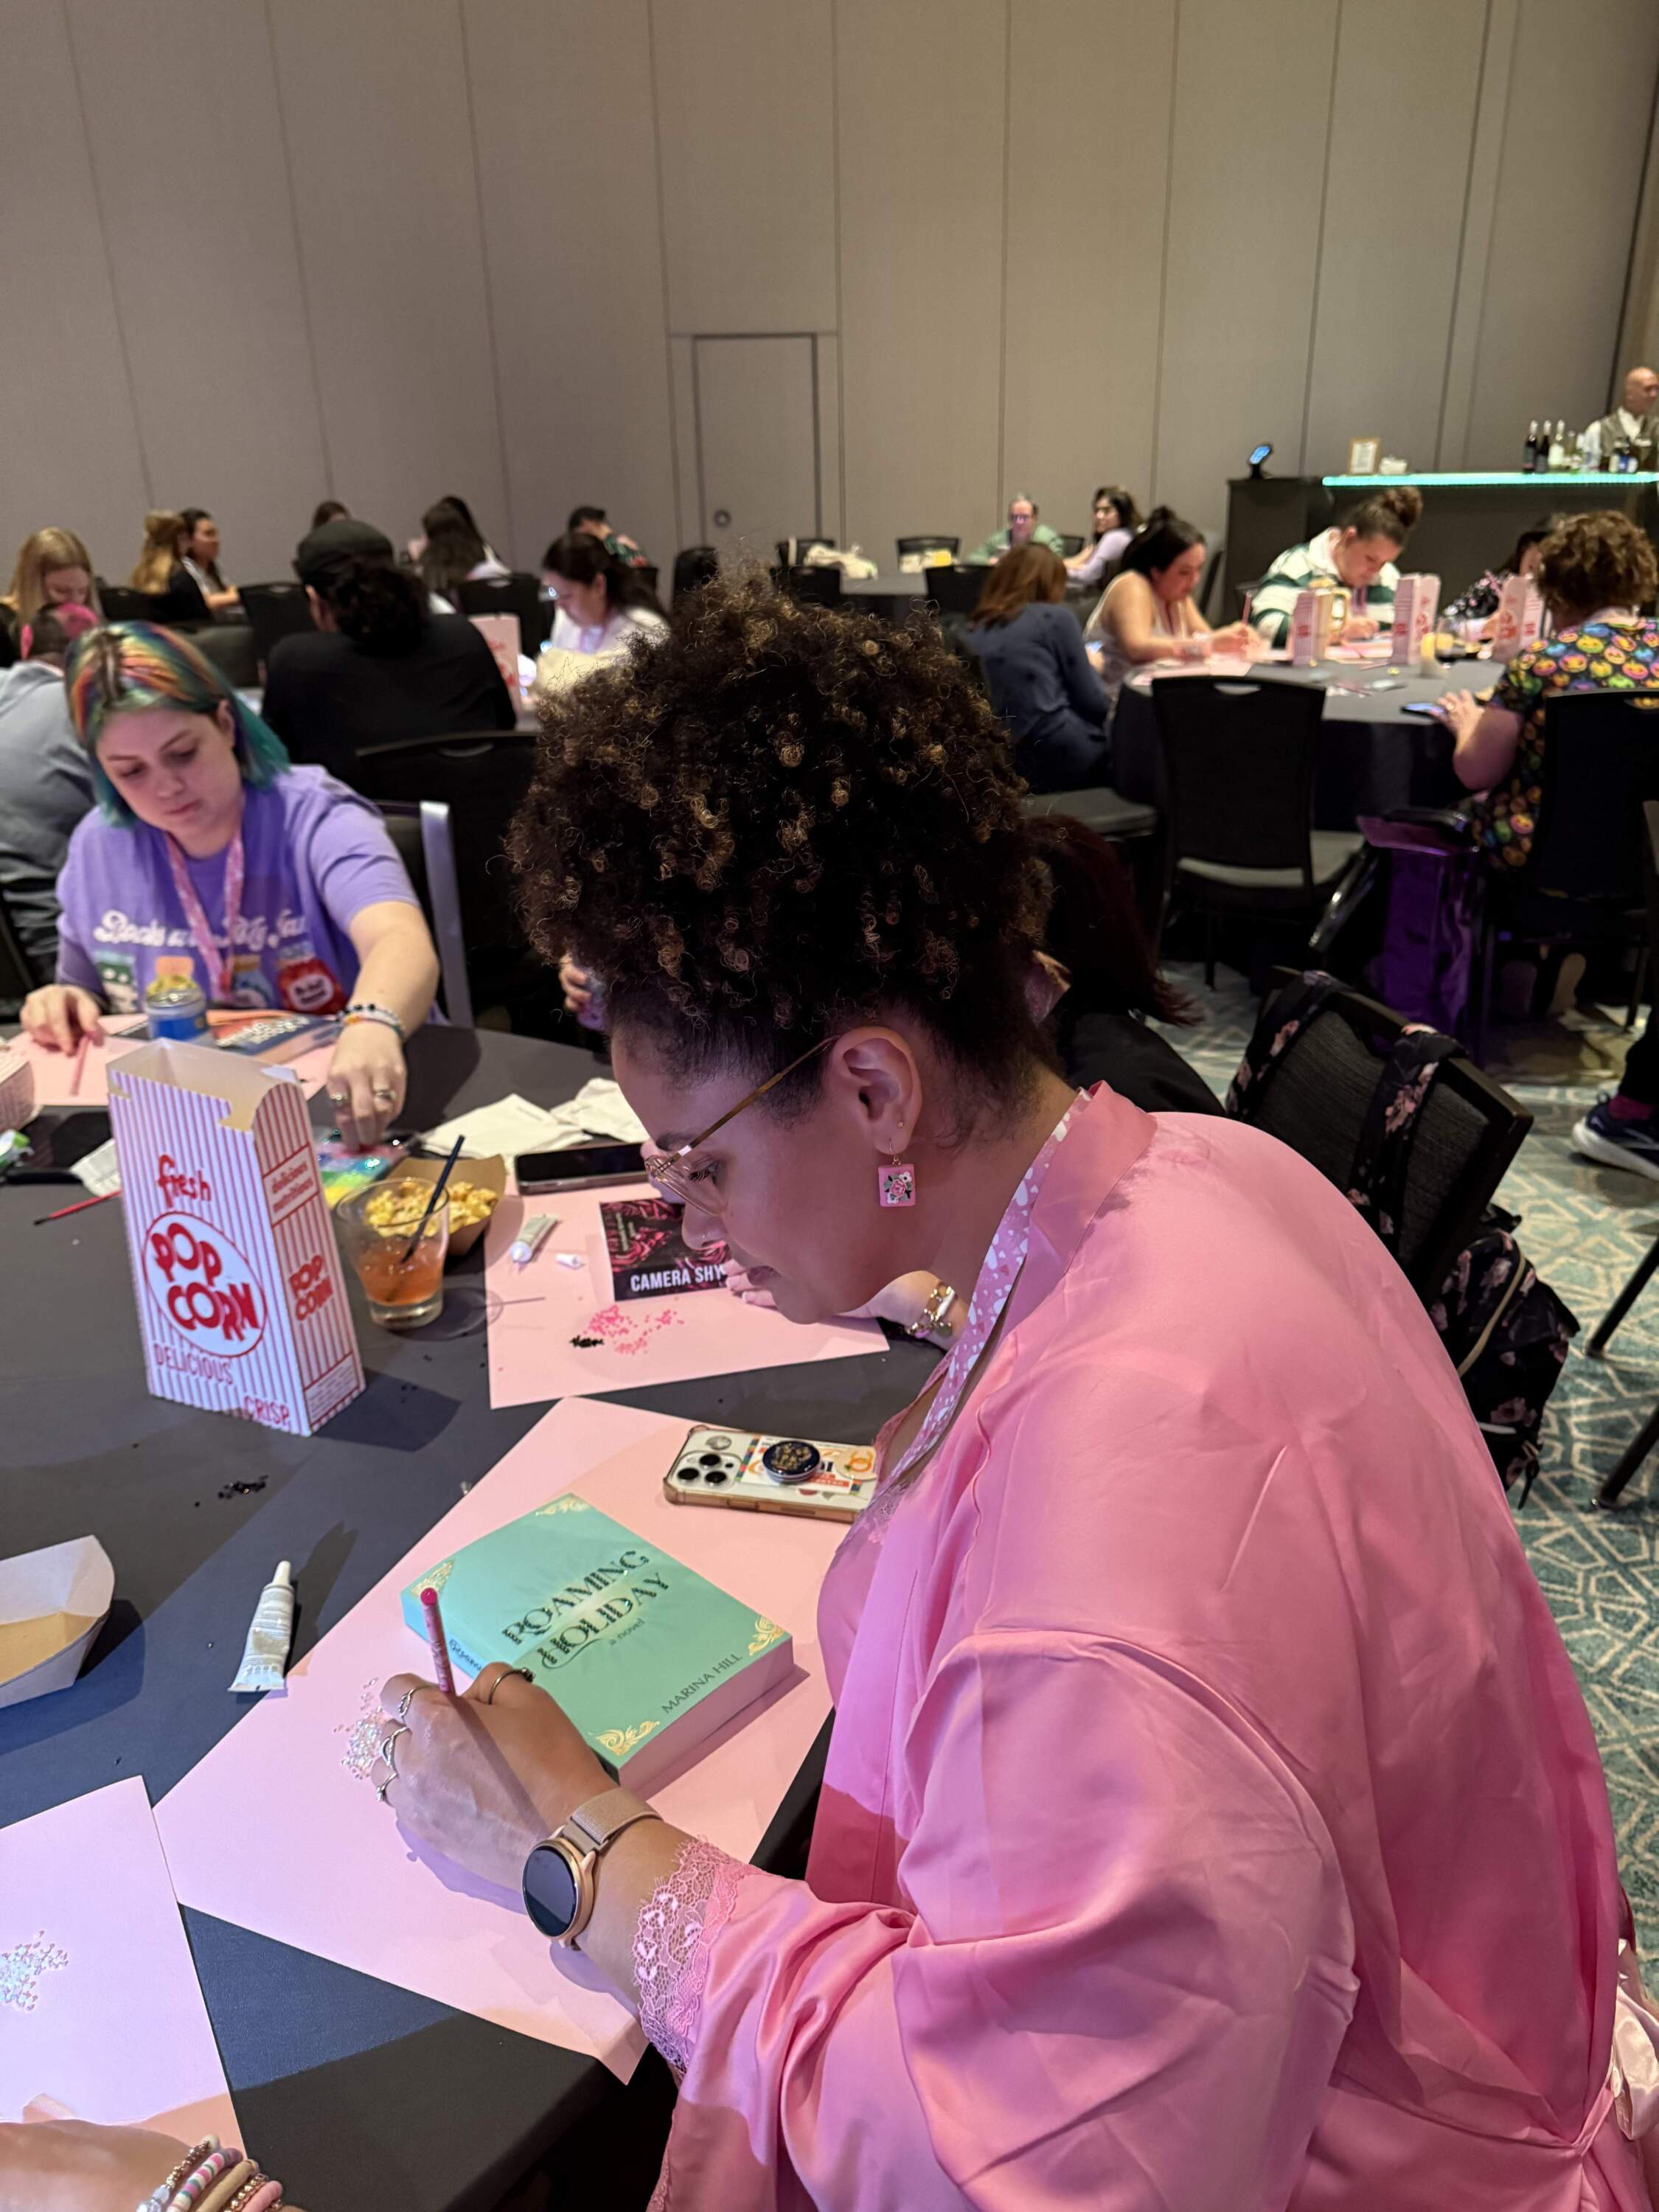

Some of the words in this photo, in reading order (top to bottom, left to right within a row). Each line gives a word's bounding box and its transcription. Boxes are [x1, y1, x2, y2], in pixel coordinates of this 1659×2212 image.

[151, 1222, 222, 1287] POP
[289, 1255, 324, 1299] POP
[630, 1267, 692, 1292] CAMERA
[694, 1264, 723, 1283] SHY
[167, 1282, 260, 1342] CORN
[296, 1276, 334, 1321] CORN
[153, 1343, 234, 1385] DELICIOUS
[501, 1550, 650, 1645] ROAMING
[537, 1572, 669, 1669] HOLIDAY
[661, 1673, 715, 1714] MARINA
[712, 1653, 743, 1674] HILL
